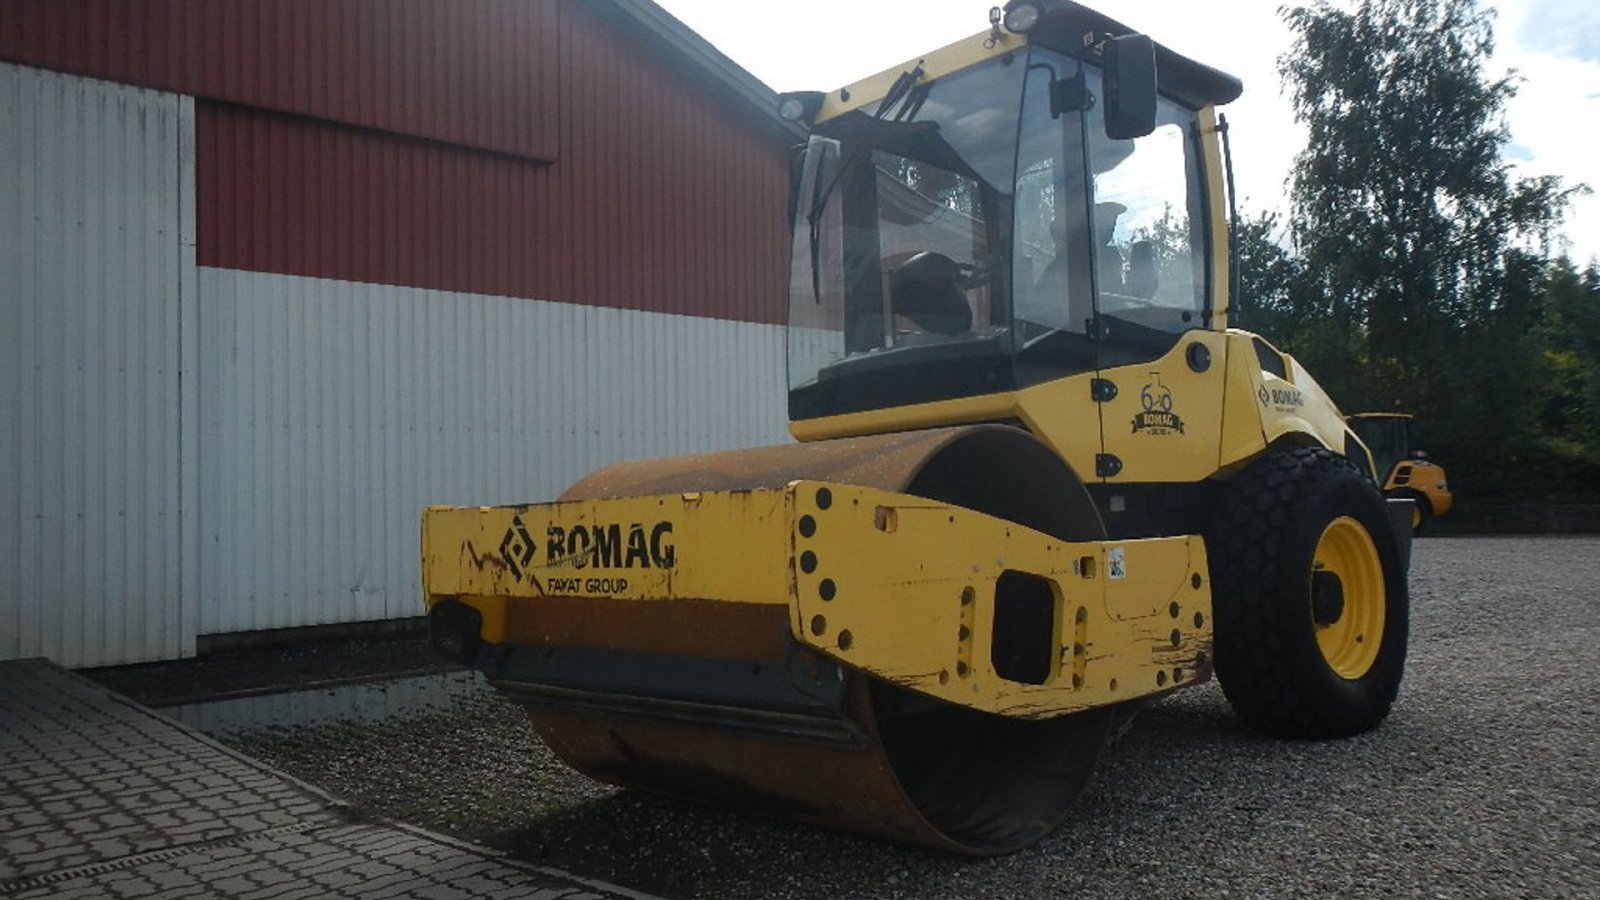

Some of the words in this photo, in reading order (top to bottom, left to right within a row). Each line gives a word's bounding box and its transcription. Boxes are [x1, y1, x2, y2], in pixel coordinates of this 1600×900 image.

[1143, 413, 1173, 426] BOMAG
[547, 521, 675, 569] BOMAG
[548, 578, 582, 593] FAYAT
[585, 578, 628, 593] GROUP
